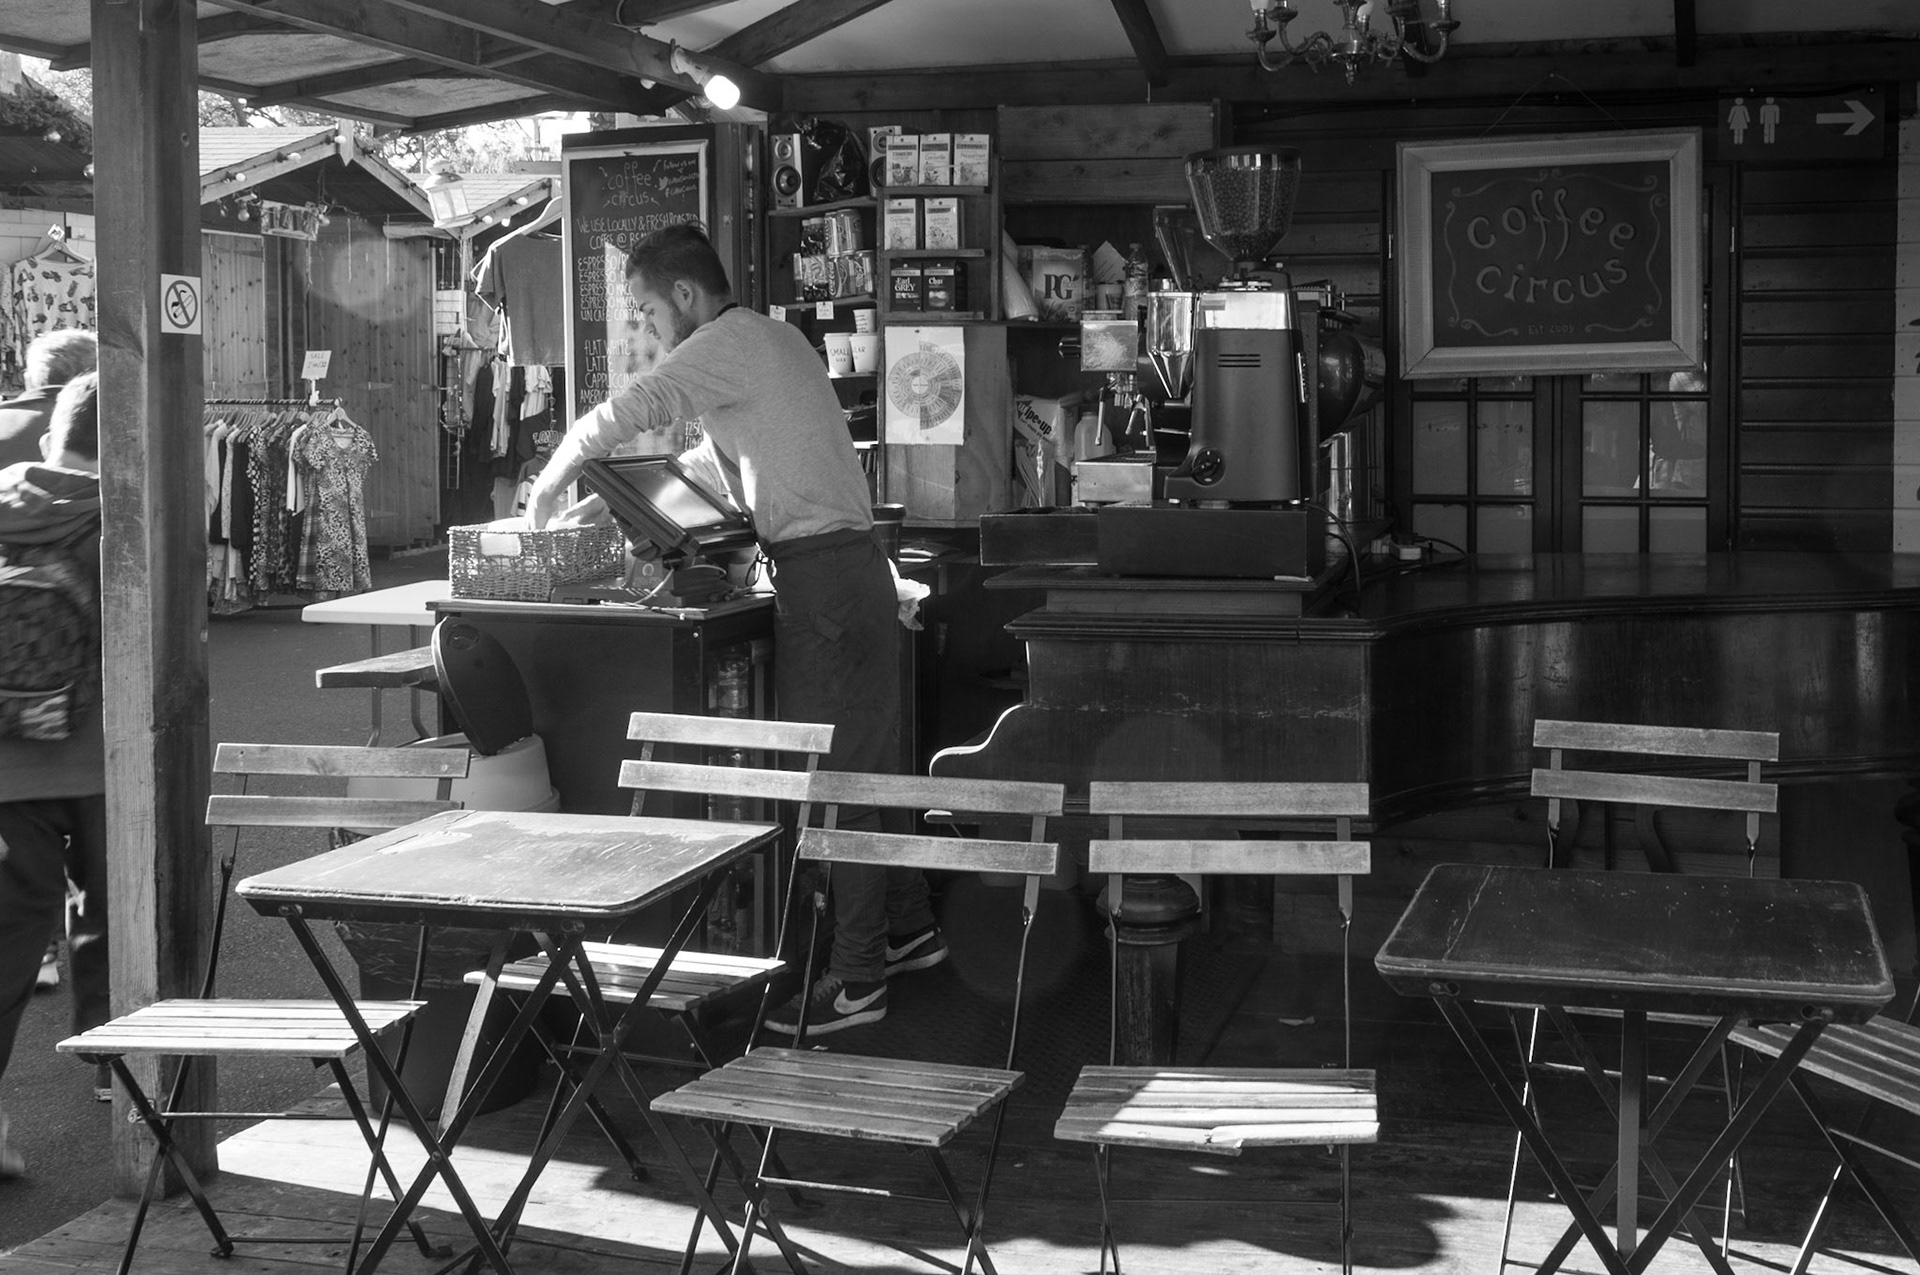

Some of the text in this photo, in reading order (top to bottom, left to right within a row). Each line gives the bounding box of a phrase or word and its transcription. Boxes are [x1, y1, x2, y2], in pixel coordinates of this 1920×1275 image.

[590, 218, 606, 232] USE
[607, 216, 637, 232] LOCALLY
[638, 216, 646, 231] &
[894, 283, 915, 291] GREY
[1044, 274, 1073, 300] PG
[585, 355, 614, 372] LATTE
